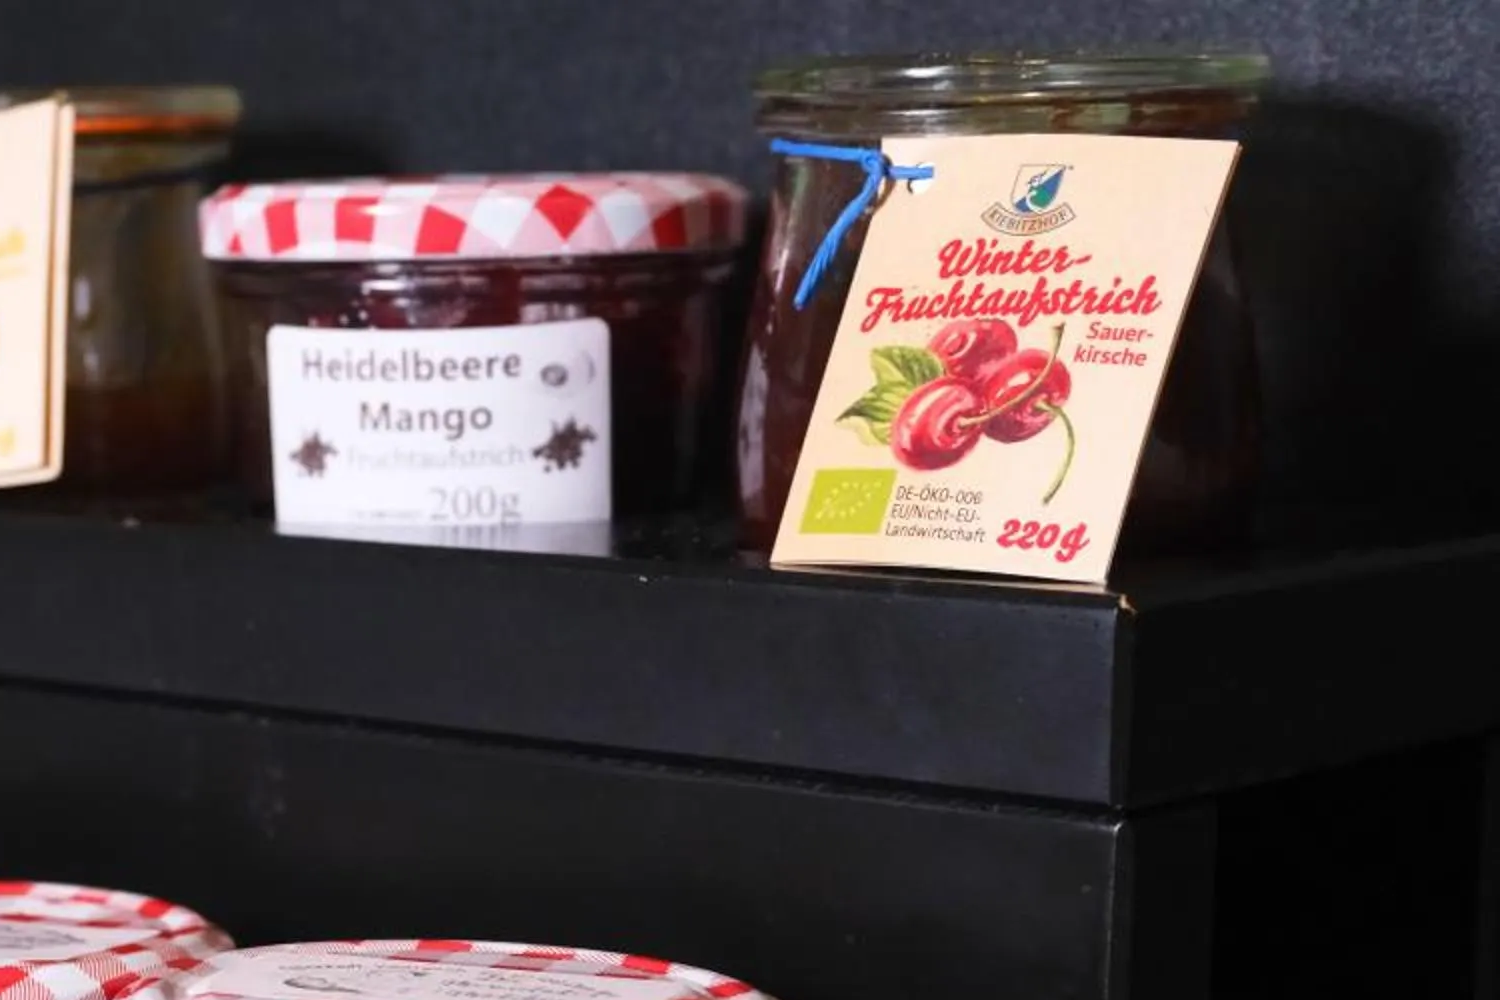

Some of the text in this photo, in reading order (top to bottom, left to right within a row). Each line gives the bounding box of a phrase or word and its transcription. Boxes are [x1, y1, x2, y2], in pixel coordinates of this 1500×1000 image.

[936, 238, 1093, 280] Winter-
[860, 275, 1163, 333] Fruchtaufstrich
[1086, 321, 1155, 344] Sauer-
[301, 348, 521, 382] Heidelbeere
[1073, 344, 1148, 367] kirsche
[359, 400, 493, 441] Mango
[429, 485, 522, 523] 200g
[884, 521, 986, 544] Landwirtschaft
